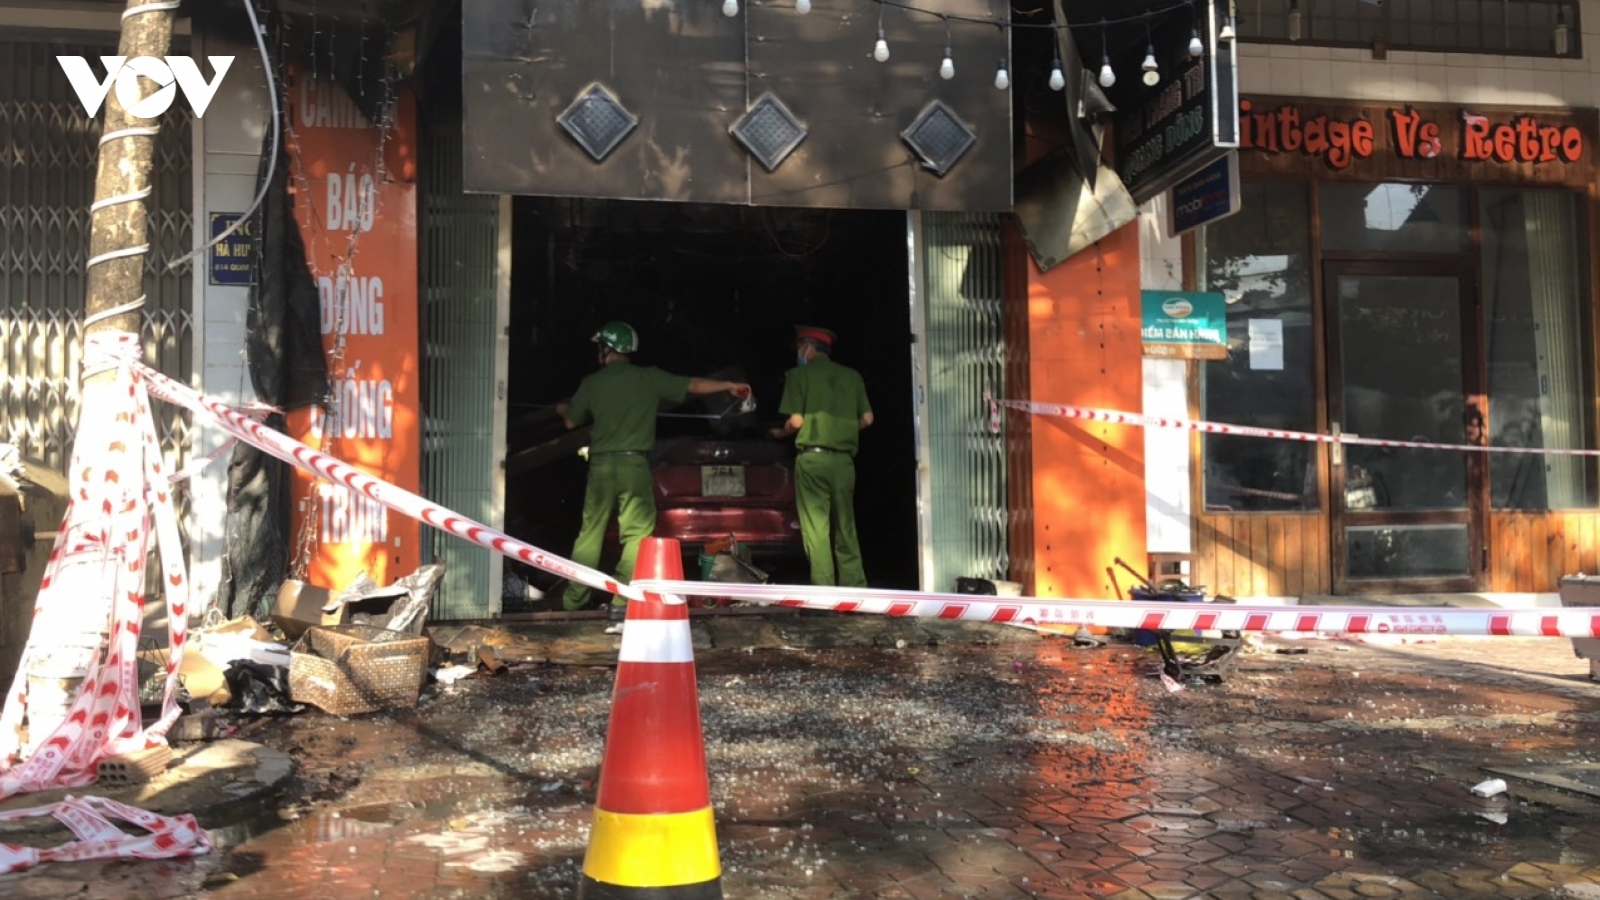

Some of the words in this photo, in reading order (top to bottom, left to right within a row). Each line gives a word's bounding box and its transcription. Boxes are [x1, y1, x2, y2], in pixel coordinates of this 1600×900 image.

[1239, 99, 1374, 168] intage
[1391, 106, 1442, 158] Vs
[1463, 111, 1582, 162] Retro
[327, 161, 374, 232] BÁO
[311, 359, 393, 438] CHỐNG
